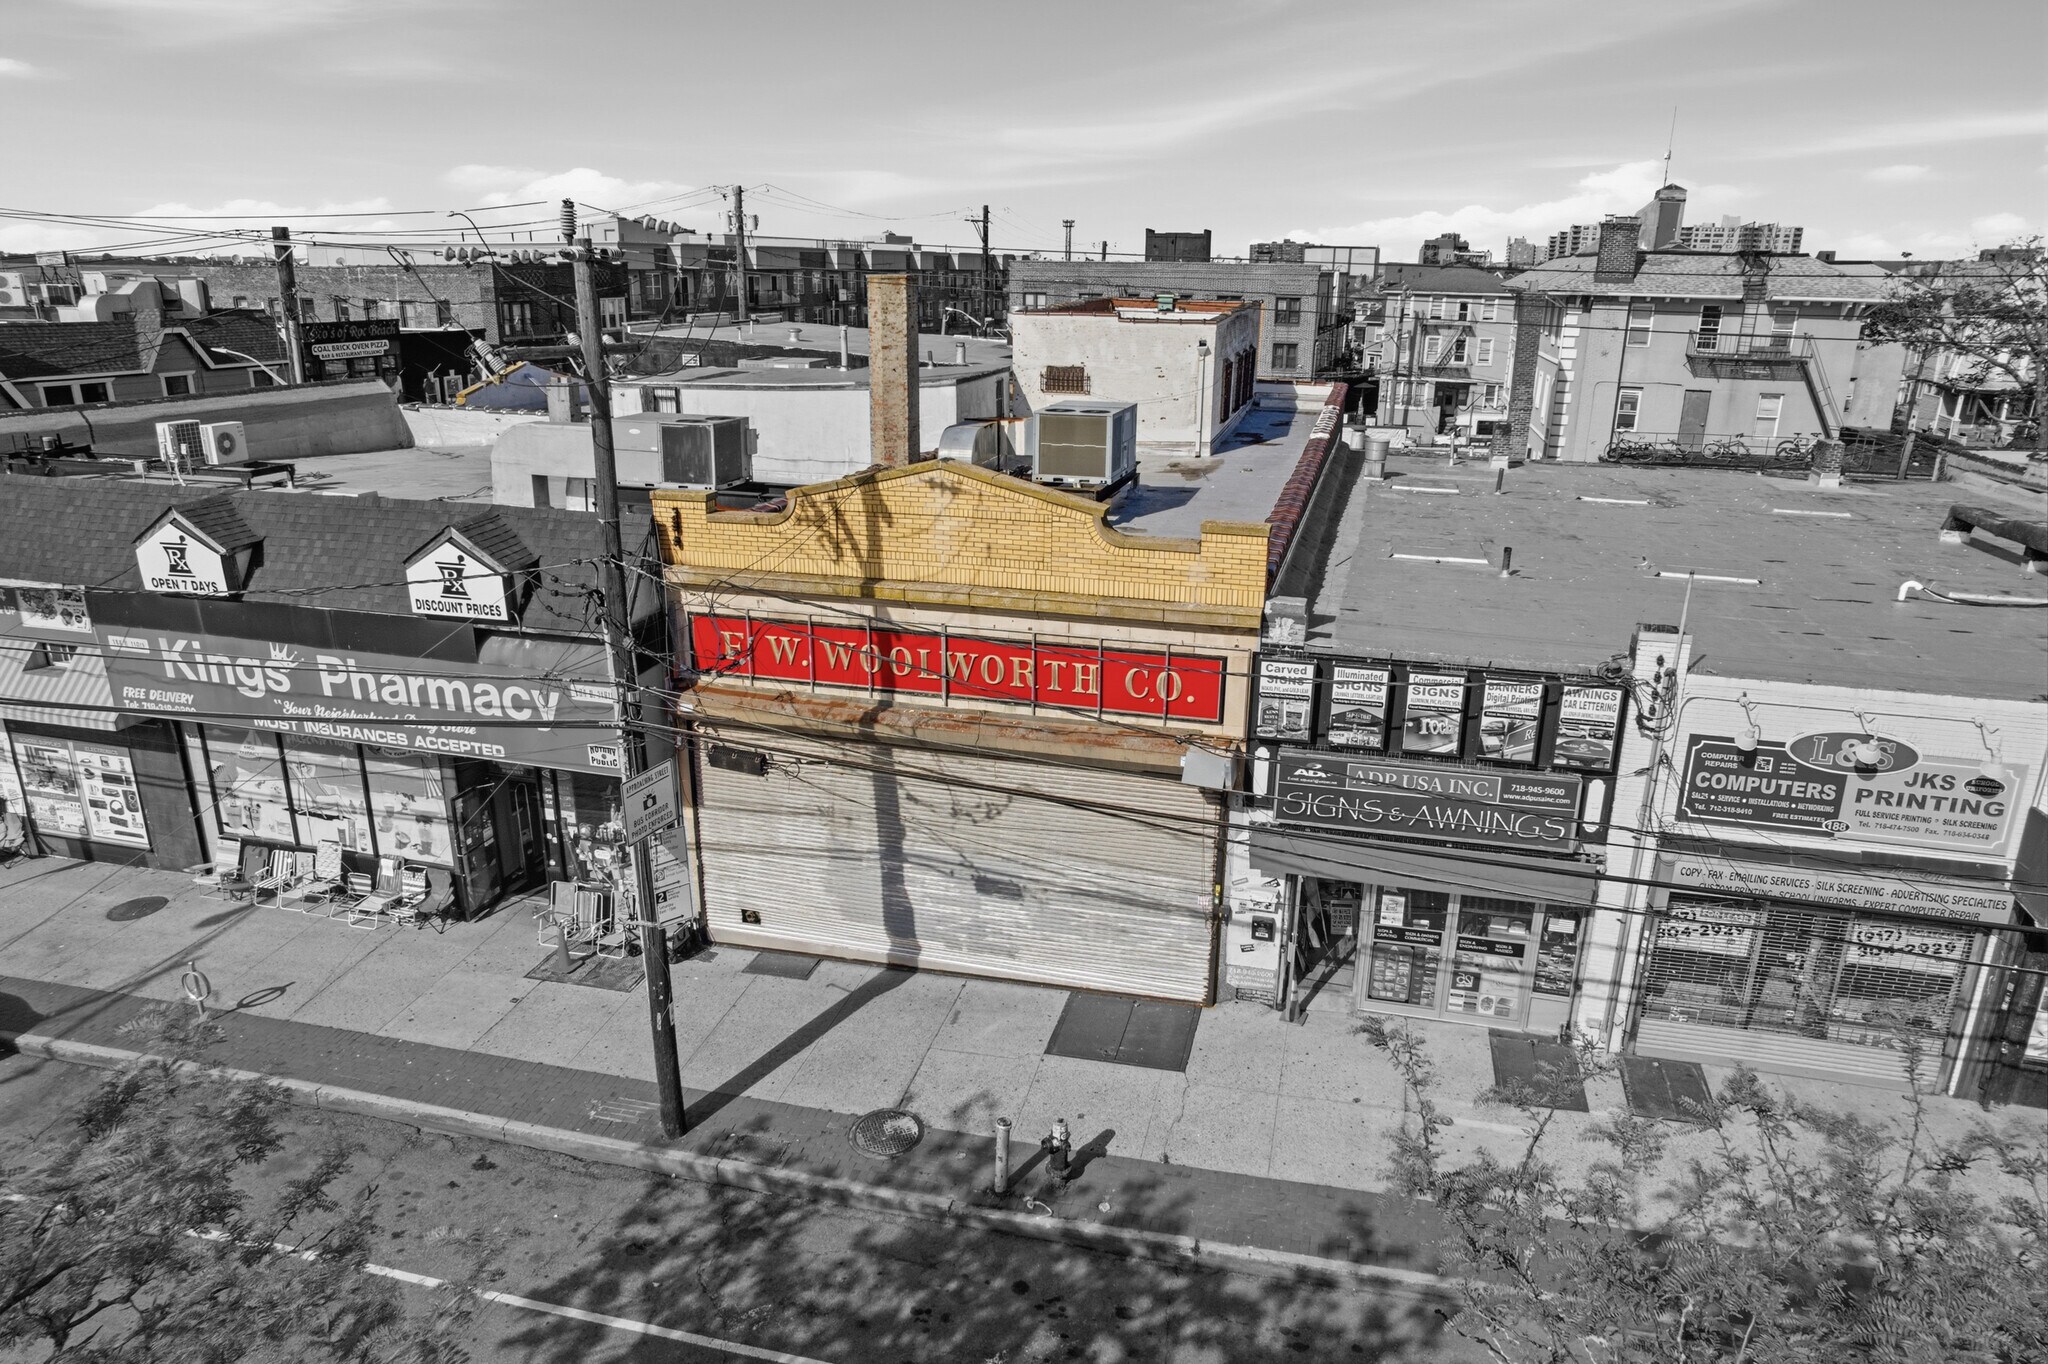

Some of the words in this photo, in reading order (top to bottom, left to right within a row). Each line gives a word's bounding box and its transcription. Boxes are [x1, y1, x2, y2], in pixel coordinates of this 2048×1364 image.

[312, 344, 331, 353] COAL
[332, 343, 351, 352] BRICK
[352, 342, 370, 350] OVEN
[371, 340, 388, 348] PIZZA
[166, 549, 190, 570] Rx
[151, 577, 180, 590] OPEN
[181, 580, 188, 590] 7
[191, 581, 219, 593] DAYS
[442, 569, 466, 593] Rx
[415, 598, 464, 614] DISCOUNT
[466, 603, 502, 617] PRICES
[764, 635, 809, 667] W.
[818, 639, 1098, 695] WOOLWORTH
[1124, 667, 1196, 703] CO.
[1265, 663, 1308, 675] Carved
[1337, 669, 1384, 681] Illuminated
[157, 637, 291, 699] Kings
[316, 654, 560, 732] Pharmacy
[1335, 682, 1383, 693] SIGNS
[1413, 674, 1462, 687] Commercial
[123, 686, 147, 699] FREE
[149, 690, 195, 705] DELIVERY
[1412, 686, 1460, 699] SIGNS
[1488, 684, 1540, 695] BANNERS
[1564, 688, 1618, 702] AWNINGS
[1486, 692, 1510, 705] Digital
[1511, 694, 1539, 708] Printing
[1563, 699, 1578, 709] CAR
[1579, 701, 1618, 713] LETTERING
[253, 718, 299, 732] MOST
[303, 721, 409, 746] INSURANCES
[414, 735, 506, 758] ACCEPTED
[591, 756, 618, 767] PUBLIC
[1701, 752, 1745, 762] COMPUTER
[1704, 760, 1738, 769] REPAIRS
[626, 774, 654, 793] APPROACHING
[654, 765, 669, 780] STREET
[1352, 769, 1397, 786] ADP
[1403, 774, 1443, 794] USA
[1448, 778, 1494, 797] INC.
[1695, 771, 1837, 800] COMPUTERS
[1903, 771, 1957, 792] JKS
[1511, 783, 1566, 796] 718-945-9600
[1502, 792, 1571, 805] www.adpusainc.com
[1717, 794, 1741, 804] SERVICE
[1748, 797, 1790, 808] INSTALLATIONS
[1797, 803, 1835, 813] NETWORKING
[1854, 787, 2006, 818] PRINTING
[633, 816, 644, 828] BUS
[1283, 791, 1384, 823] SIGNS
[1388, 806, 1406, 822] &
[1408, 803, 1566, 842] AWNINGS
[1772, 812, 1789, 820] FREE
[1789, 814, 1826, 823] ESTIMATES
[1854, 809, 1871, 818] FULL
[1872, 811, 1900, 821] SERVICE
[1900, 814, 1933, 824] PRINTING
[1942, 818, 1958, 826] SILK
[1958, 820, 1998, 831] SCREENING
[1858, 820, 1871, 828] Tel.
[1826, 821, 1846, 832] 188
[1680, 866, 1703, 878] COPY
[1708, 870, 1724, 880] FAX
[1728, 871, 1769, 885] EMAILING
[1769, 876, 1810, 889] SERVICES
[1816, 880, 1835, 892] SILK
[1835, 882, 1885, 897] SCREENING
[1890, 889, 1950, 904] ADVERTISING
[1951, 896, 2008, 910] SPECIALTIES
[657, 891, 665, 904] 2
[1814, 894, 1857, 907] UNIFORMS
[1863, 900, 1899, 912] EXPERT
[1899, 904, 1946, 917] COMPUTER
[1949, 909, 1981, 921] REPAIR
